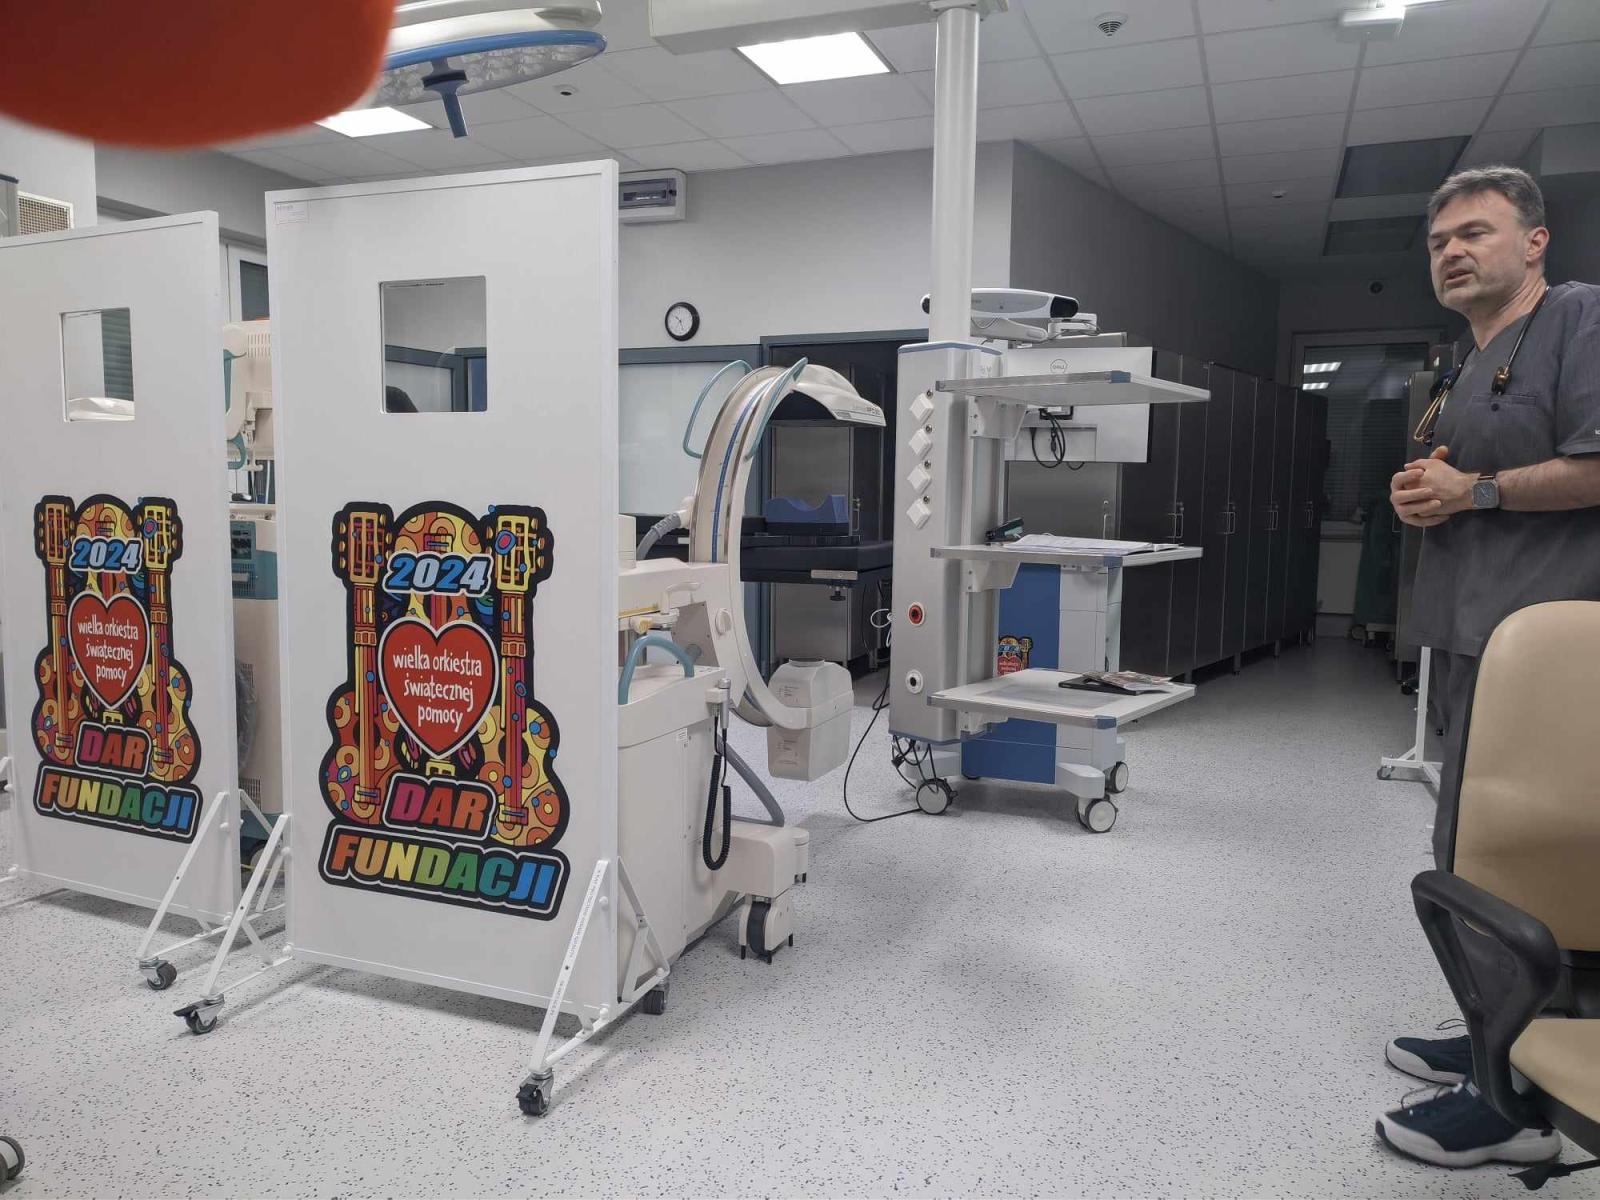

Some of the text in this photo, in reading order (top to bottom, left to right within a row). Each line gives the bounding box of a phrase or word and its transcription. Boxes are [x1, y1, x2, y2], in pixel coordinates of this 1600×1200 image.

[72, 540, 140, 570] 2024
[386, 556, 488, 592] 2024
[77, 614, 139, 641] wielka orkiestra
[85, 639, 134, 670] świątecznej
[392, 645, 483, 678] wielka orkiestra
[96, 665, 127, 687] pomocy
[403, 672, 474, 712] świątecznej
[417, 705, 463, 732] pomocy
[80, 729, 147, 770] DAR
[40, 773, 194, 830] FUNDACJI
[389, 782, 489, 832] DAR
[330, 834, 556, 904] FUNDACJI
